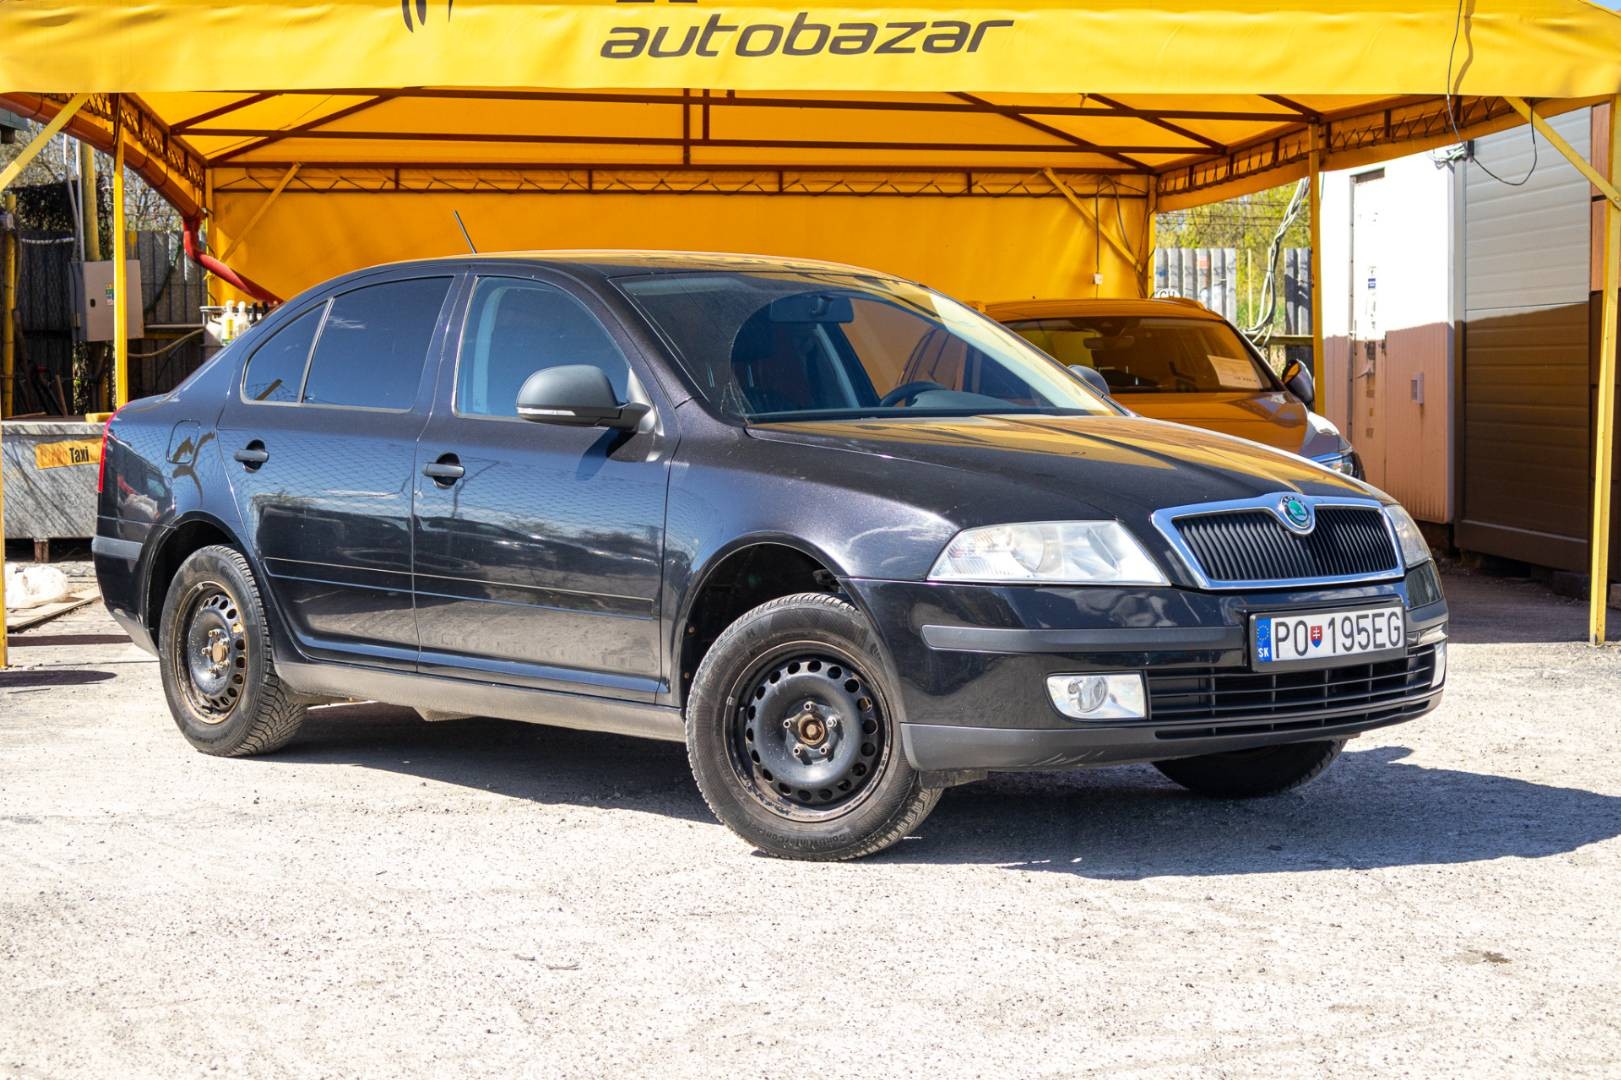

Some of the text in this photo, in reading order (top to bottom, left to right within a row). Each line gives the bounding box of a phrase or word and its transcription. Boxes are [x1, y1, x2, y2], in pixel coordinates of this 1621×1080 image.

[600, 13, 1014, 59] autobazar
[69, 446, 90, 463] Taxi
[1258, 647, 1269, 658] SK
